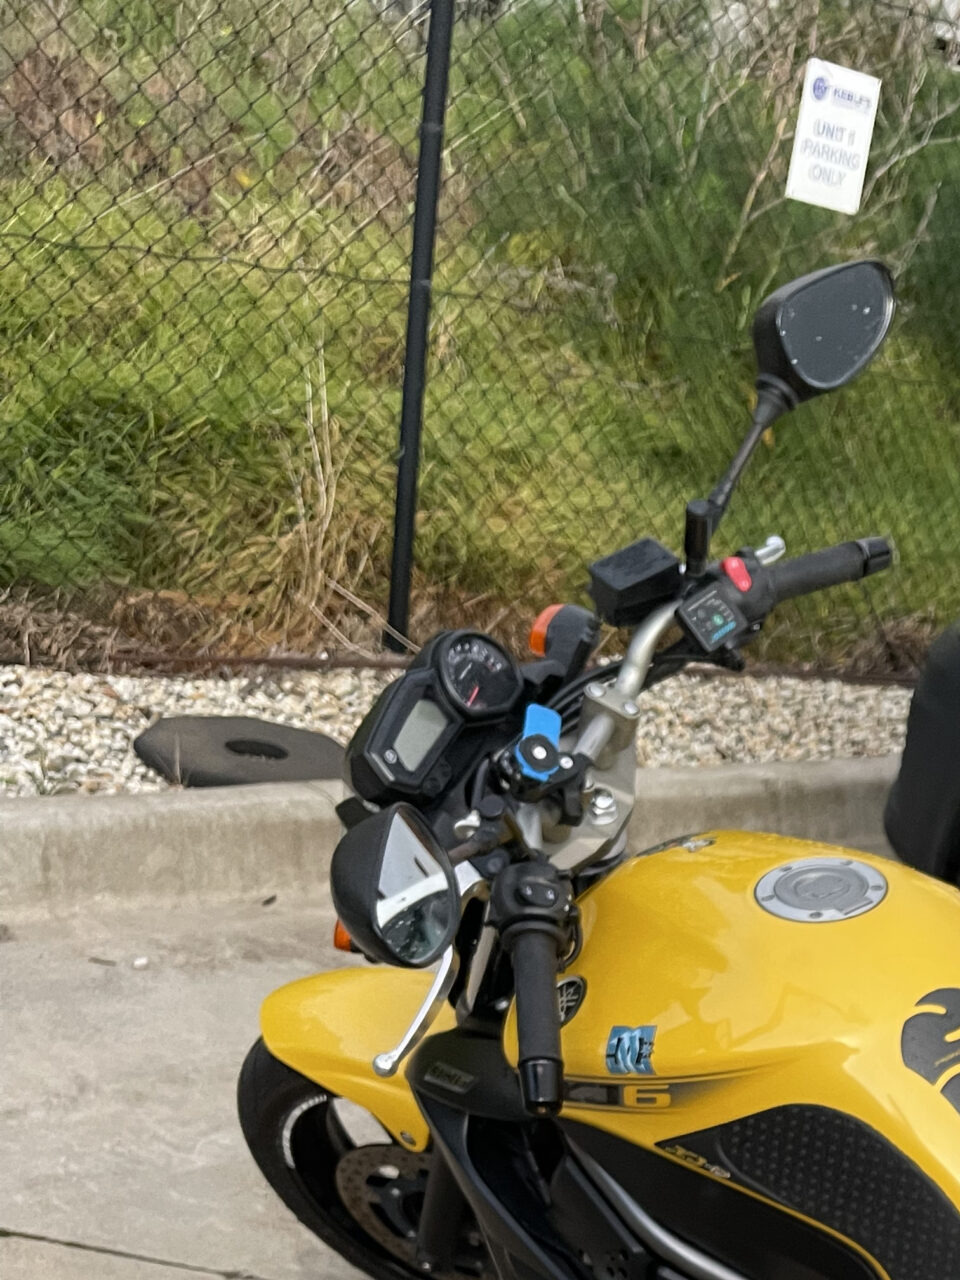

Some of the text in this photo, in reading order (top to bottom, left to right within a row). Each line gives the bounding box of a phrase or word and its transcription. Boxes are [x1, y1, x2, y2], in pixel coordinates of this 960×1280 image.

[813, 118, 846, 141] UNIT
[801, 139, 861, 171] PARKING
[809, 164, 846, 187] ONLY
